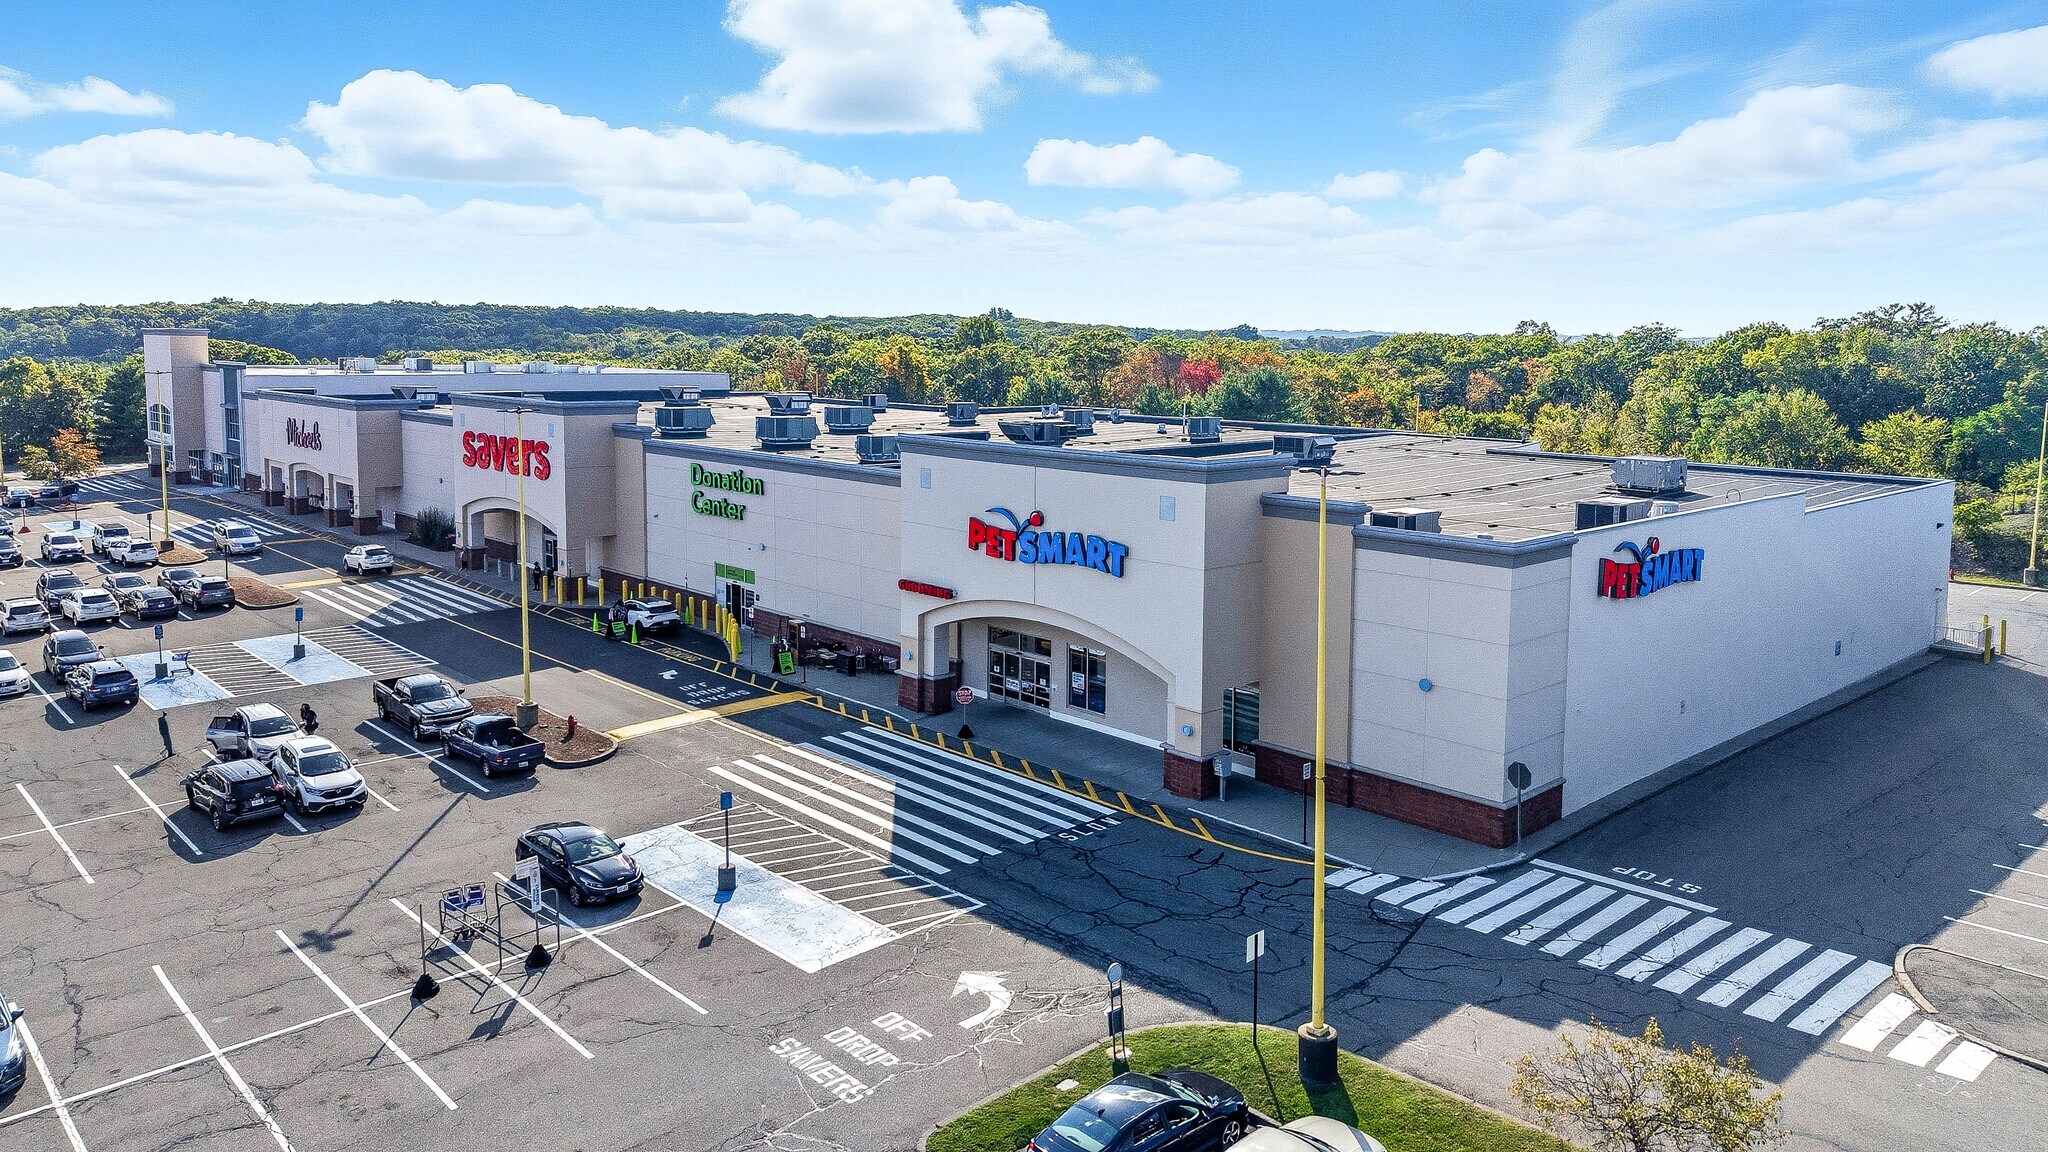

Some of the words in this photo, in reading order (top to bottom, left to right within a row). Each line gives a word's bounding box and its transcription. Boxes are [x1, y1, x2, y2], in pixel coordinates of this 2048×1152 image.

[286, 417, 322, 451] Michaels
[690, 463, 765, 496] Donation
[691, 490, 746, 520] Center
[968, 516, 1129, 578] PETSMART
[1597, 548, 1705, 599] PETSMART
[1058, 817, 1121, 841] SLOW
[1612, 866, 1702, 893] STOP
[871, 1011, 934, 1042] OFF
[823, 1025, 900, 1066] DROP
[768, 1037, 874, 1104] SAVERS
